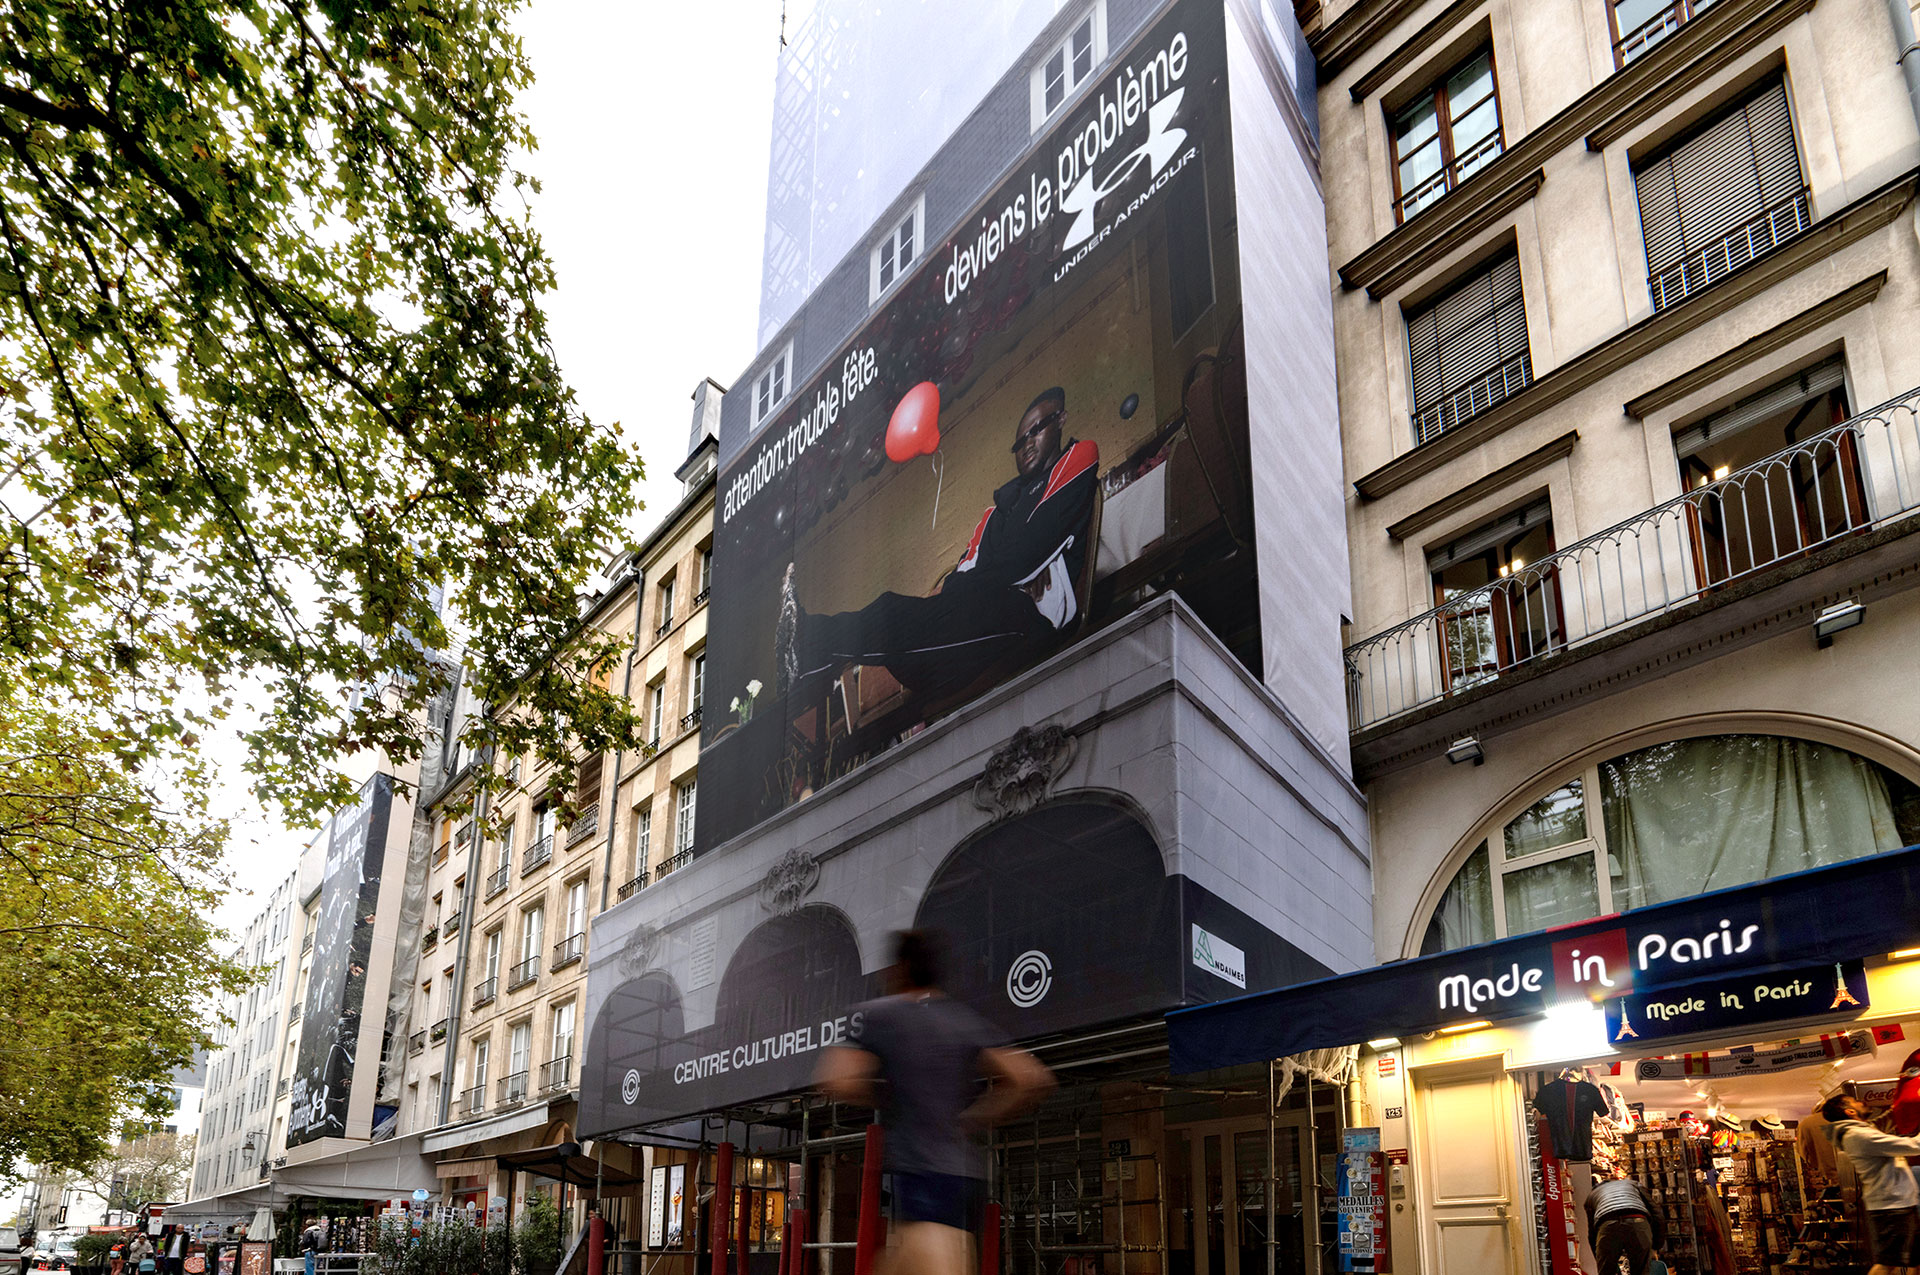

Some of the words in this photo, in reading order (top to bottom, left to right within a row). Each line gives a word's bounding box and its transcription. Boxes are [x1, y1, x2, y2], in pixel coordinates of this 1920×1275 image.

[944, 194, 1026, 304] deviens
[1031, 173, 1051, 230] le
[1058, 31, 1188, 212] problème
[1054, 225, 1111, 282] UNDER
[1114, 146, 1196, 230] ARMOUR
[723, 437, 785, 524] attention:
[787, 381, 839, 465] trouble
[842, 347, 879, 408] fête.
[1439, 963, 1544, 1013] Made
[1571, 949, 1615, 987] in
[1638, 918, 1759, 971] Paris
[1646, 997, 1706, 1021] Made
[1720, 991, 1744, 1010] in
[1754, 979, 1813, 1003] Paris
[674, 1050, 730, 1085] CENTRE
[732, 1026, 818, 1070] CULTUREL
[1387, 1108, 1400, 1117] 125
[1864, 1088, 1897, 1102] Coca-C
[1339, 1196, 1384, 1206] MEDAILLES
